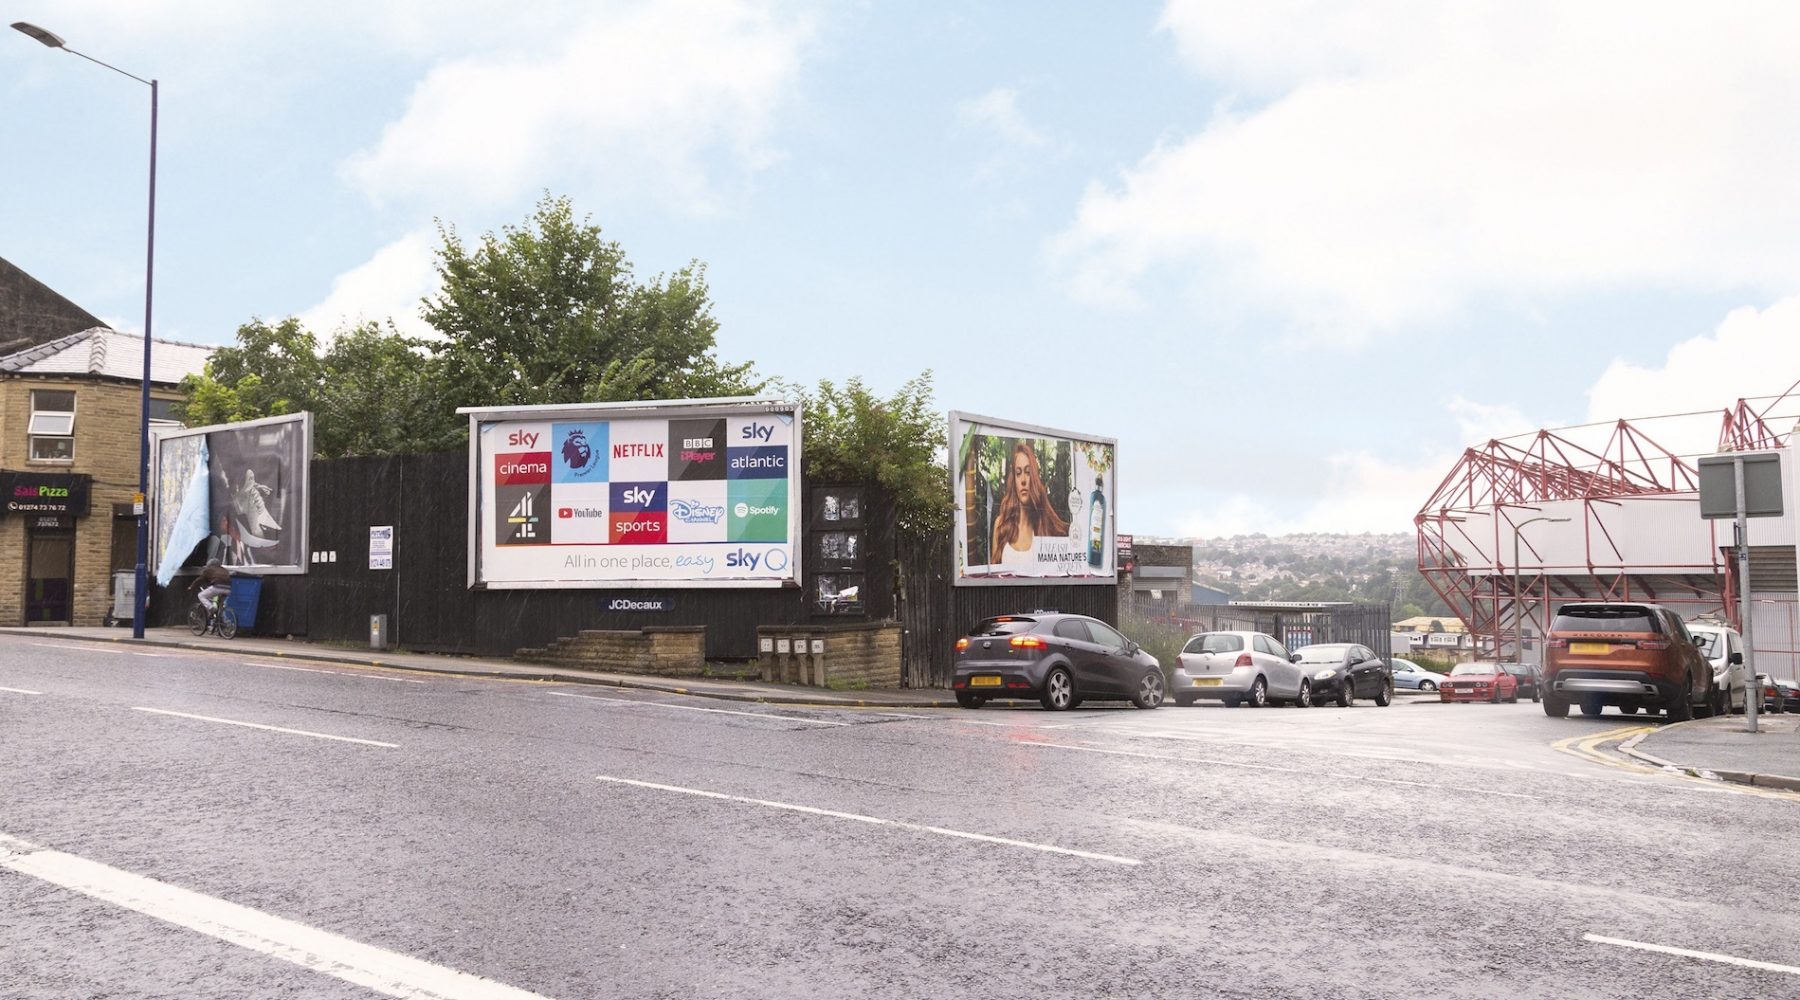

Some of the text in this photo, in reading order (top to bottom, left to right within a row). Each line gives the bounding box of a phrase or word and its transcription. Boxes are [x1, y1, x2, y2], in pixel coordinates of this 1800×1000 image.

[509, 429, 539, 449] sky
[742, 422, 774, 442] sky
[683, 438, 713, 448] BBC
[613, 443, 664, 459] NETFLIX
[500, 461, 547, 475] cinema
[731, 455, 784, 469] atlantic
[39, 486, 68, 497] Pizza
[623, 486, 655, 507] sky
[574, 508, 602, 518] YouTube
[749, 506, 779, 516] Spotify
[616, 520, 661, 534] sports
[564, 554, 715, 574] All in one place, easy
[726, 548, 788, 571] sky Q
[1037, 553, 1058, 563] MAMA
[608, 599, 662, 610] JCDecaux
